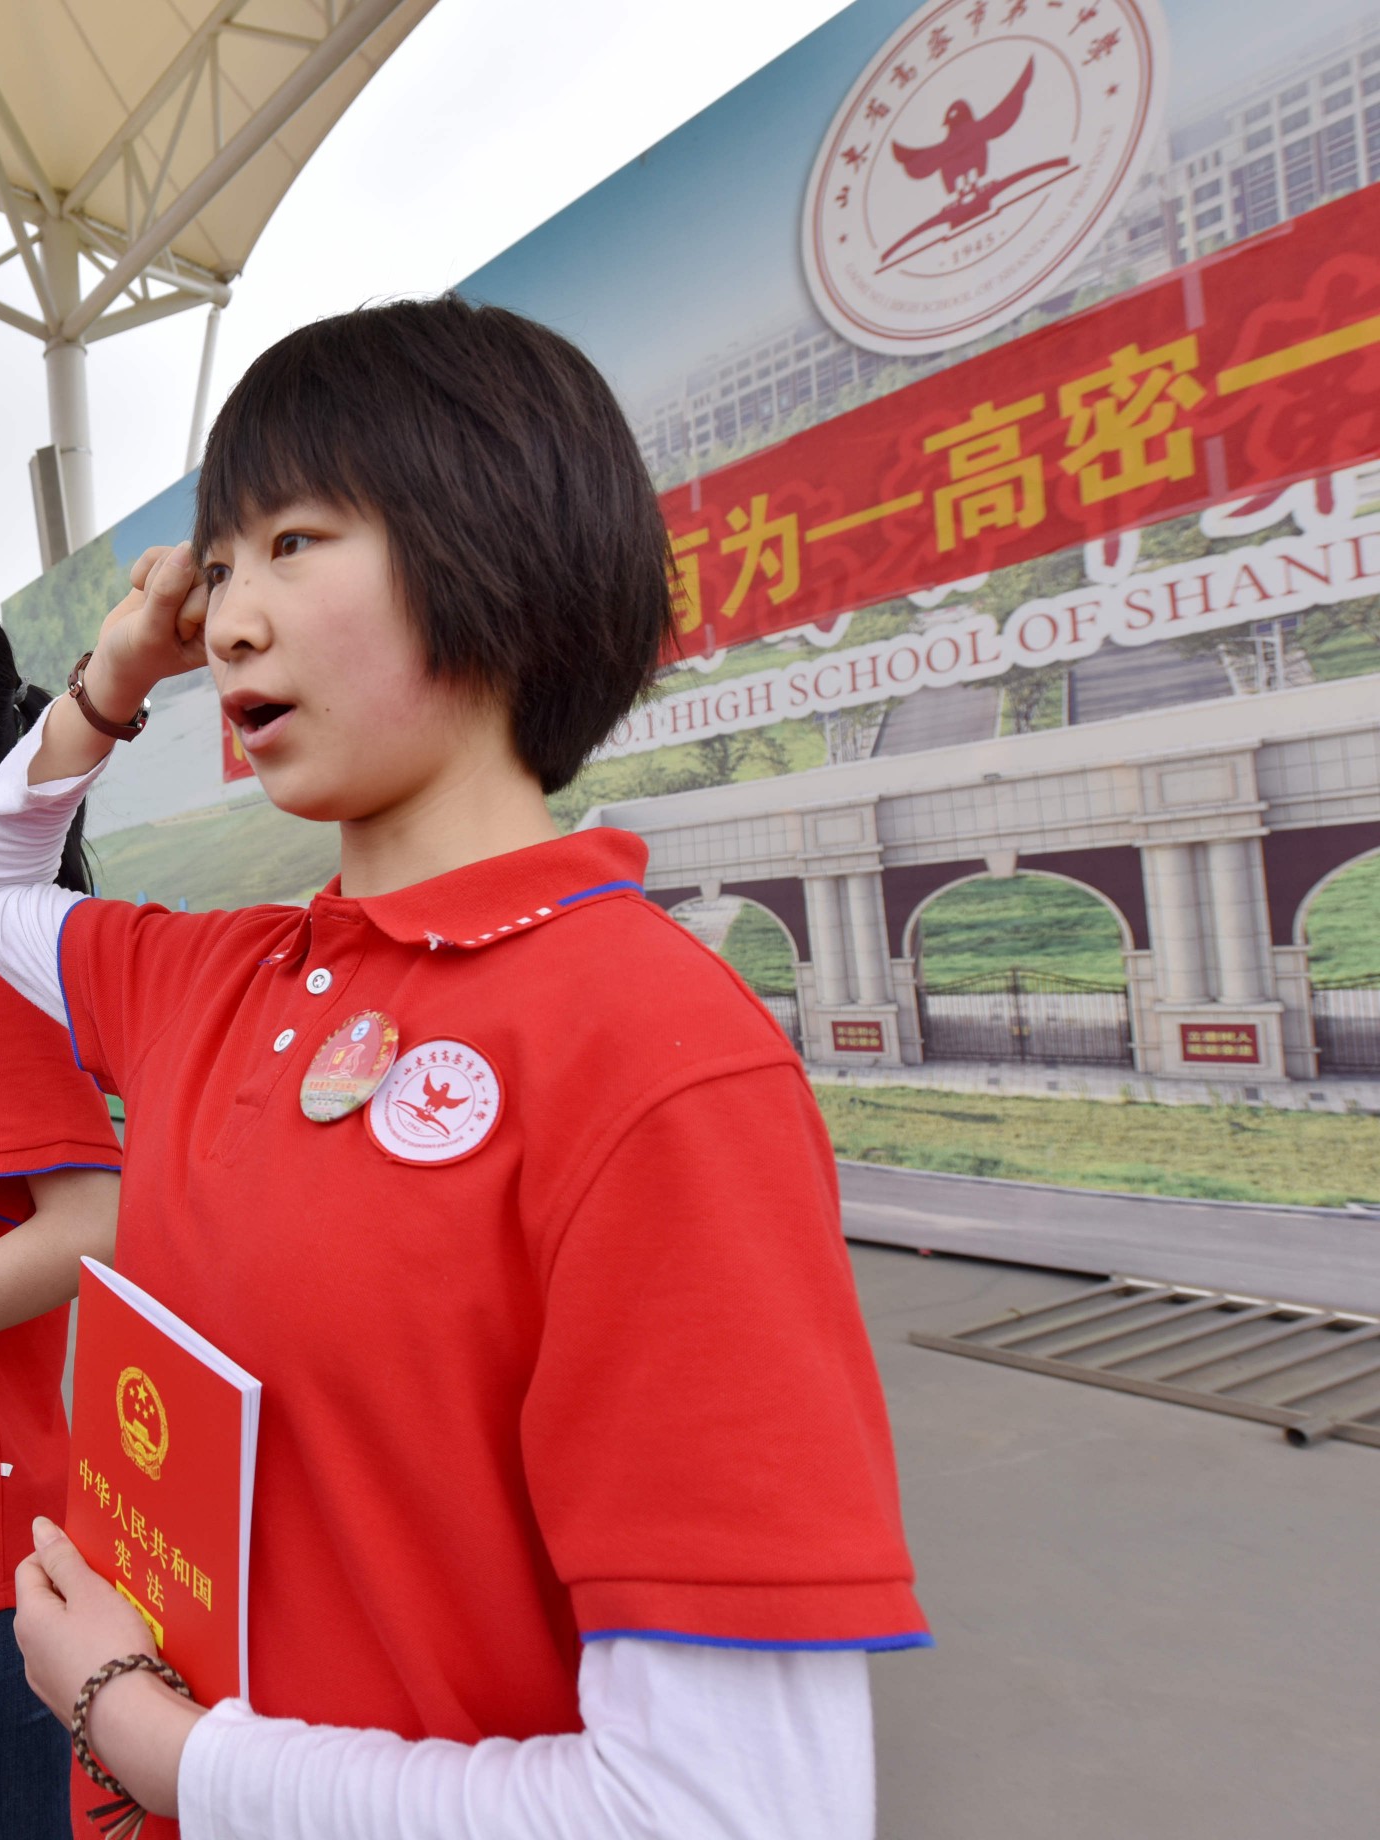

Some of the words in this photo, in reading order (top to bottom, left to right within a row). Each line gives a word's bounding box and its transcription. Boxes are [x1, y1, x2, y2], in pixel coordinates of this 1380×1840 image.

[952, 230, 996, 264] 1945
[669, 681, 775, 735] HIGH
[789, 629, 1002, 706] SCHOOL
[1017, 600, 1102, 653] OF
[78, 1457, 213, 1612] 中华人民共和国
[114, 1538, 165, 1613] 宪法
